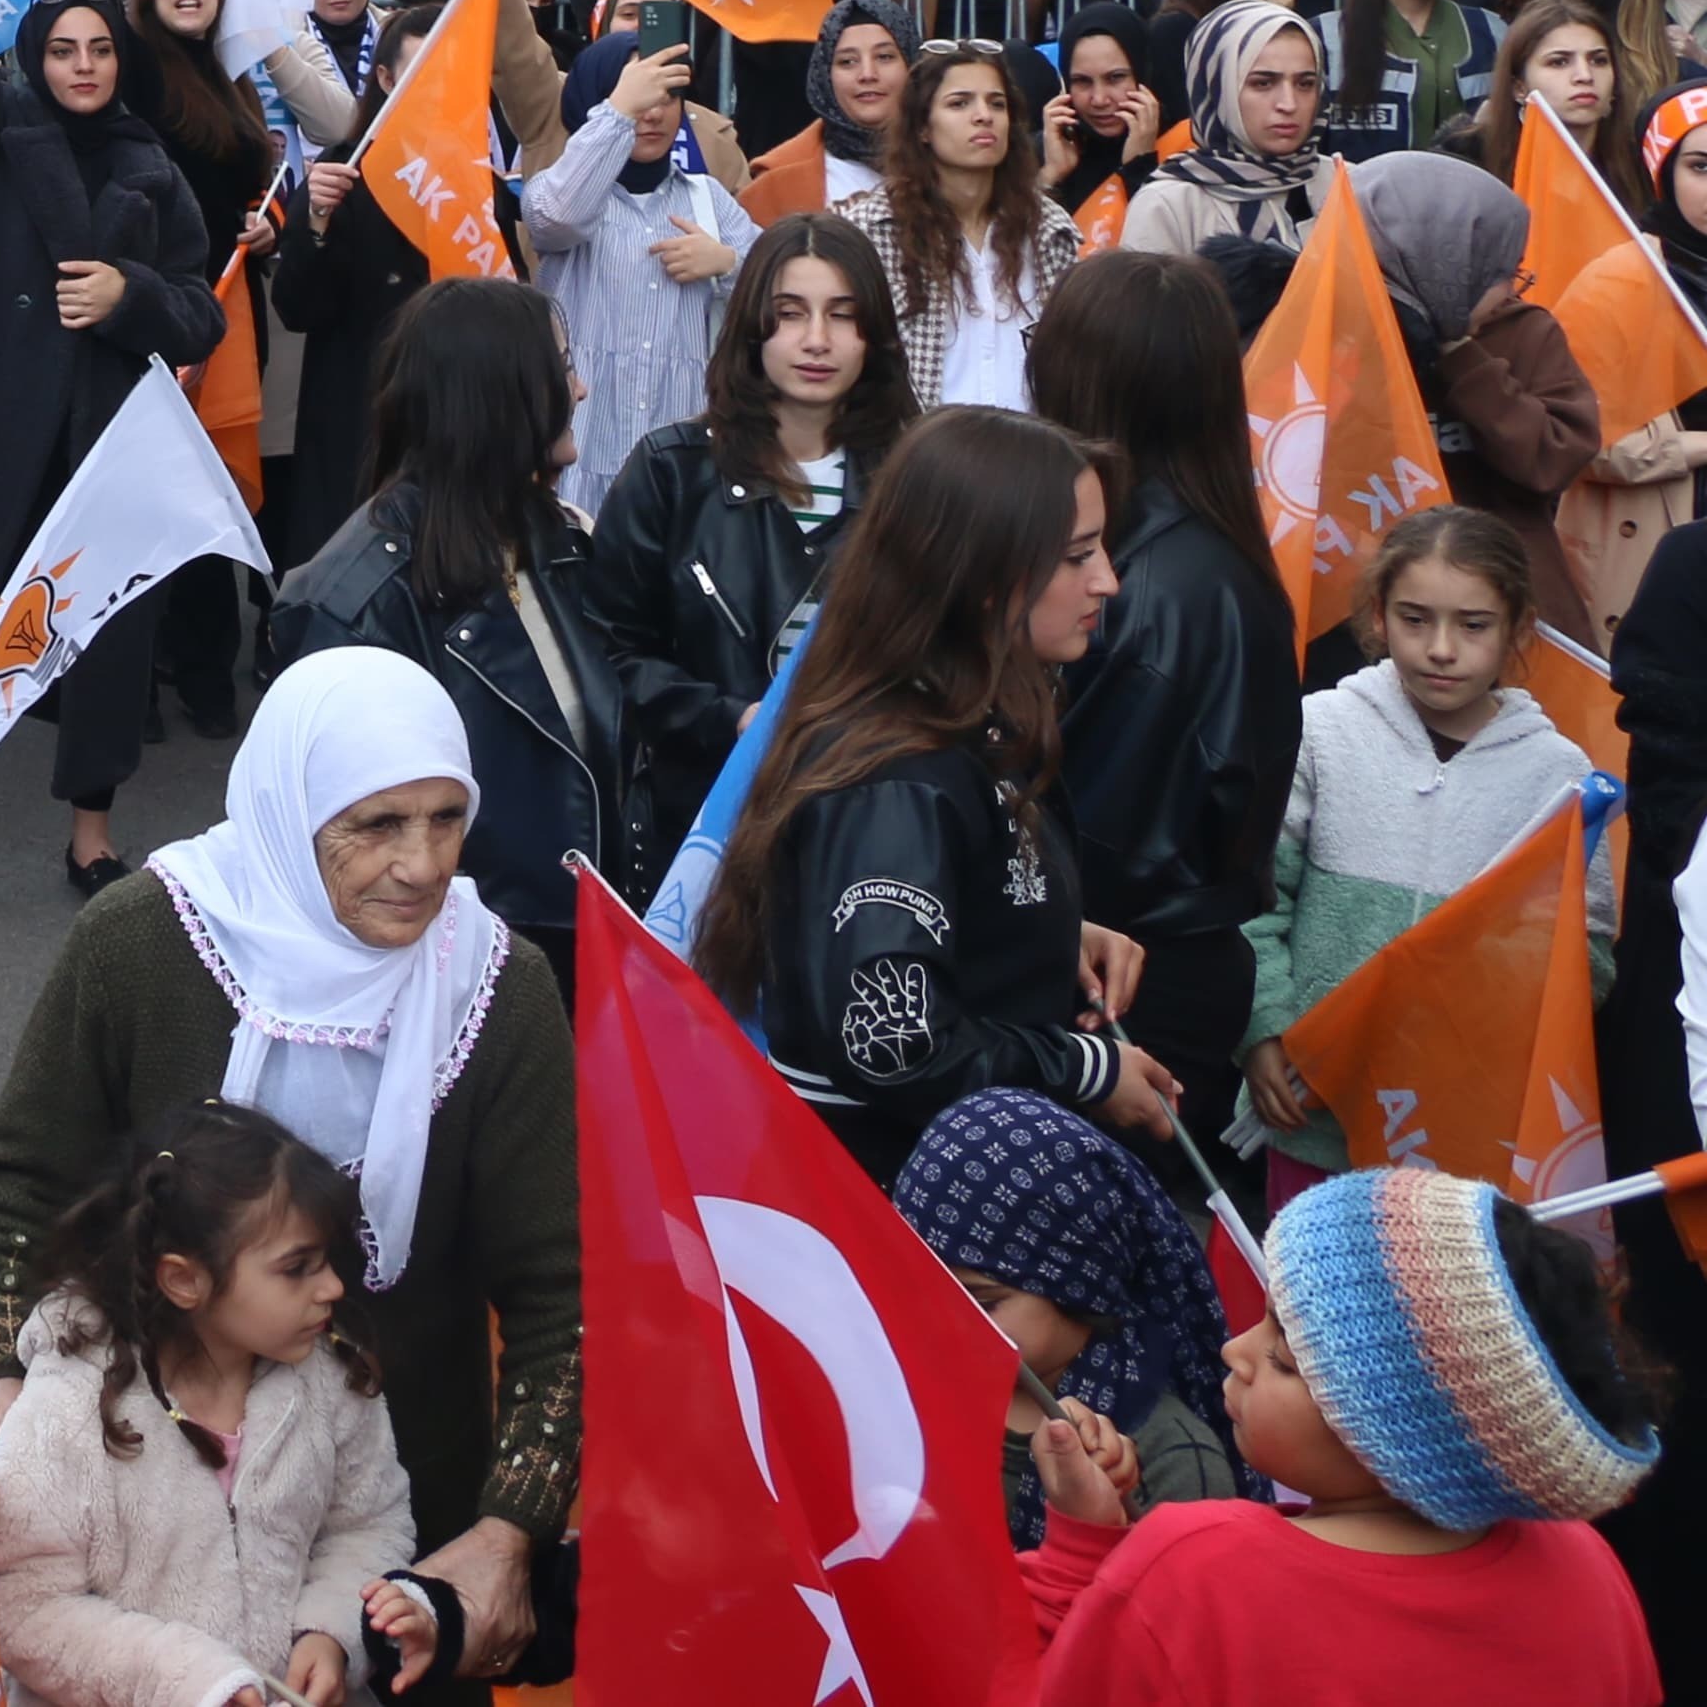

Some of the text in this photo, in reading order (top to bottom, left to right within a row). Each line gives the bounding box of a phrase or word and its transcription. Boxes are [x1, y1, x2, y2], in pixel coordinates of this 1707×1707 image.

[394, 155, 457, 224] AK
[843, 884, 938, 917] OH HOW PUNK
